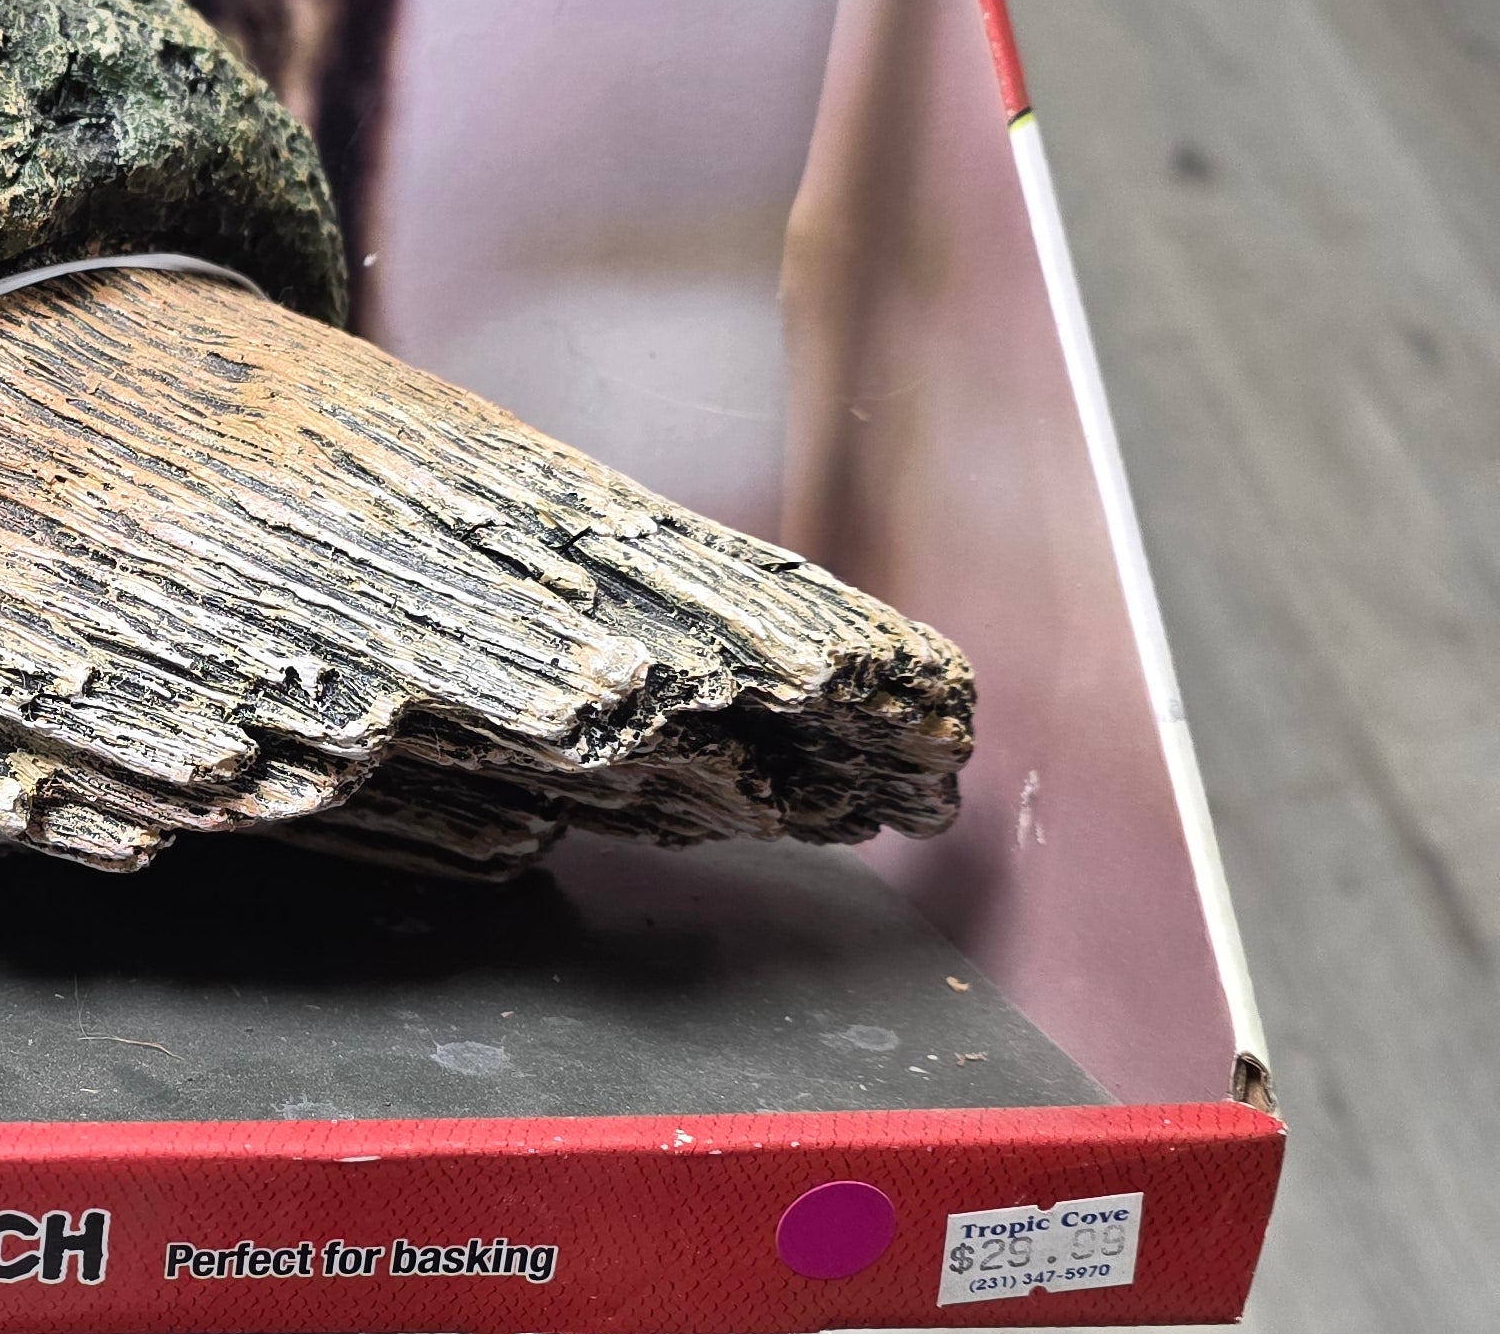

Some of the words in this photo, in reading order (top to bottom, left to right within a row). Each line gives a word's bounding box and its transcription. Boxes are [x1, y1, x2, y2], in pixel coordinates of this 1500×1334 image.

[962, 1216, 1050, 1239] Tropic
[1060, 1209, 1130, 1227] Cove
[164, 1242, 313, 1279] Perfect
[321, 1239, 384, 1277] for
[390, 1238, 559, 1283] basking
[969, 1275, 1017, 1293] (231)
[1022, 1264, 1111, 1286] 347-5970
